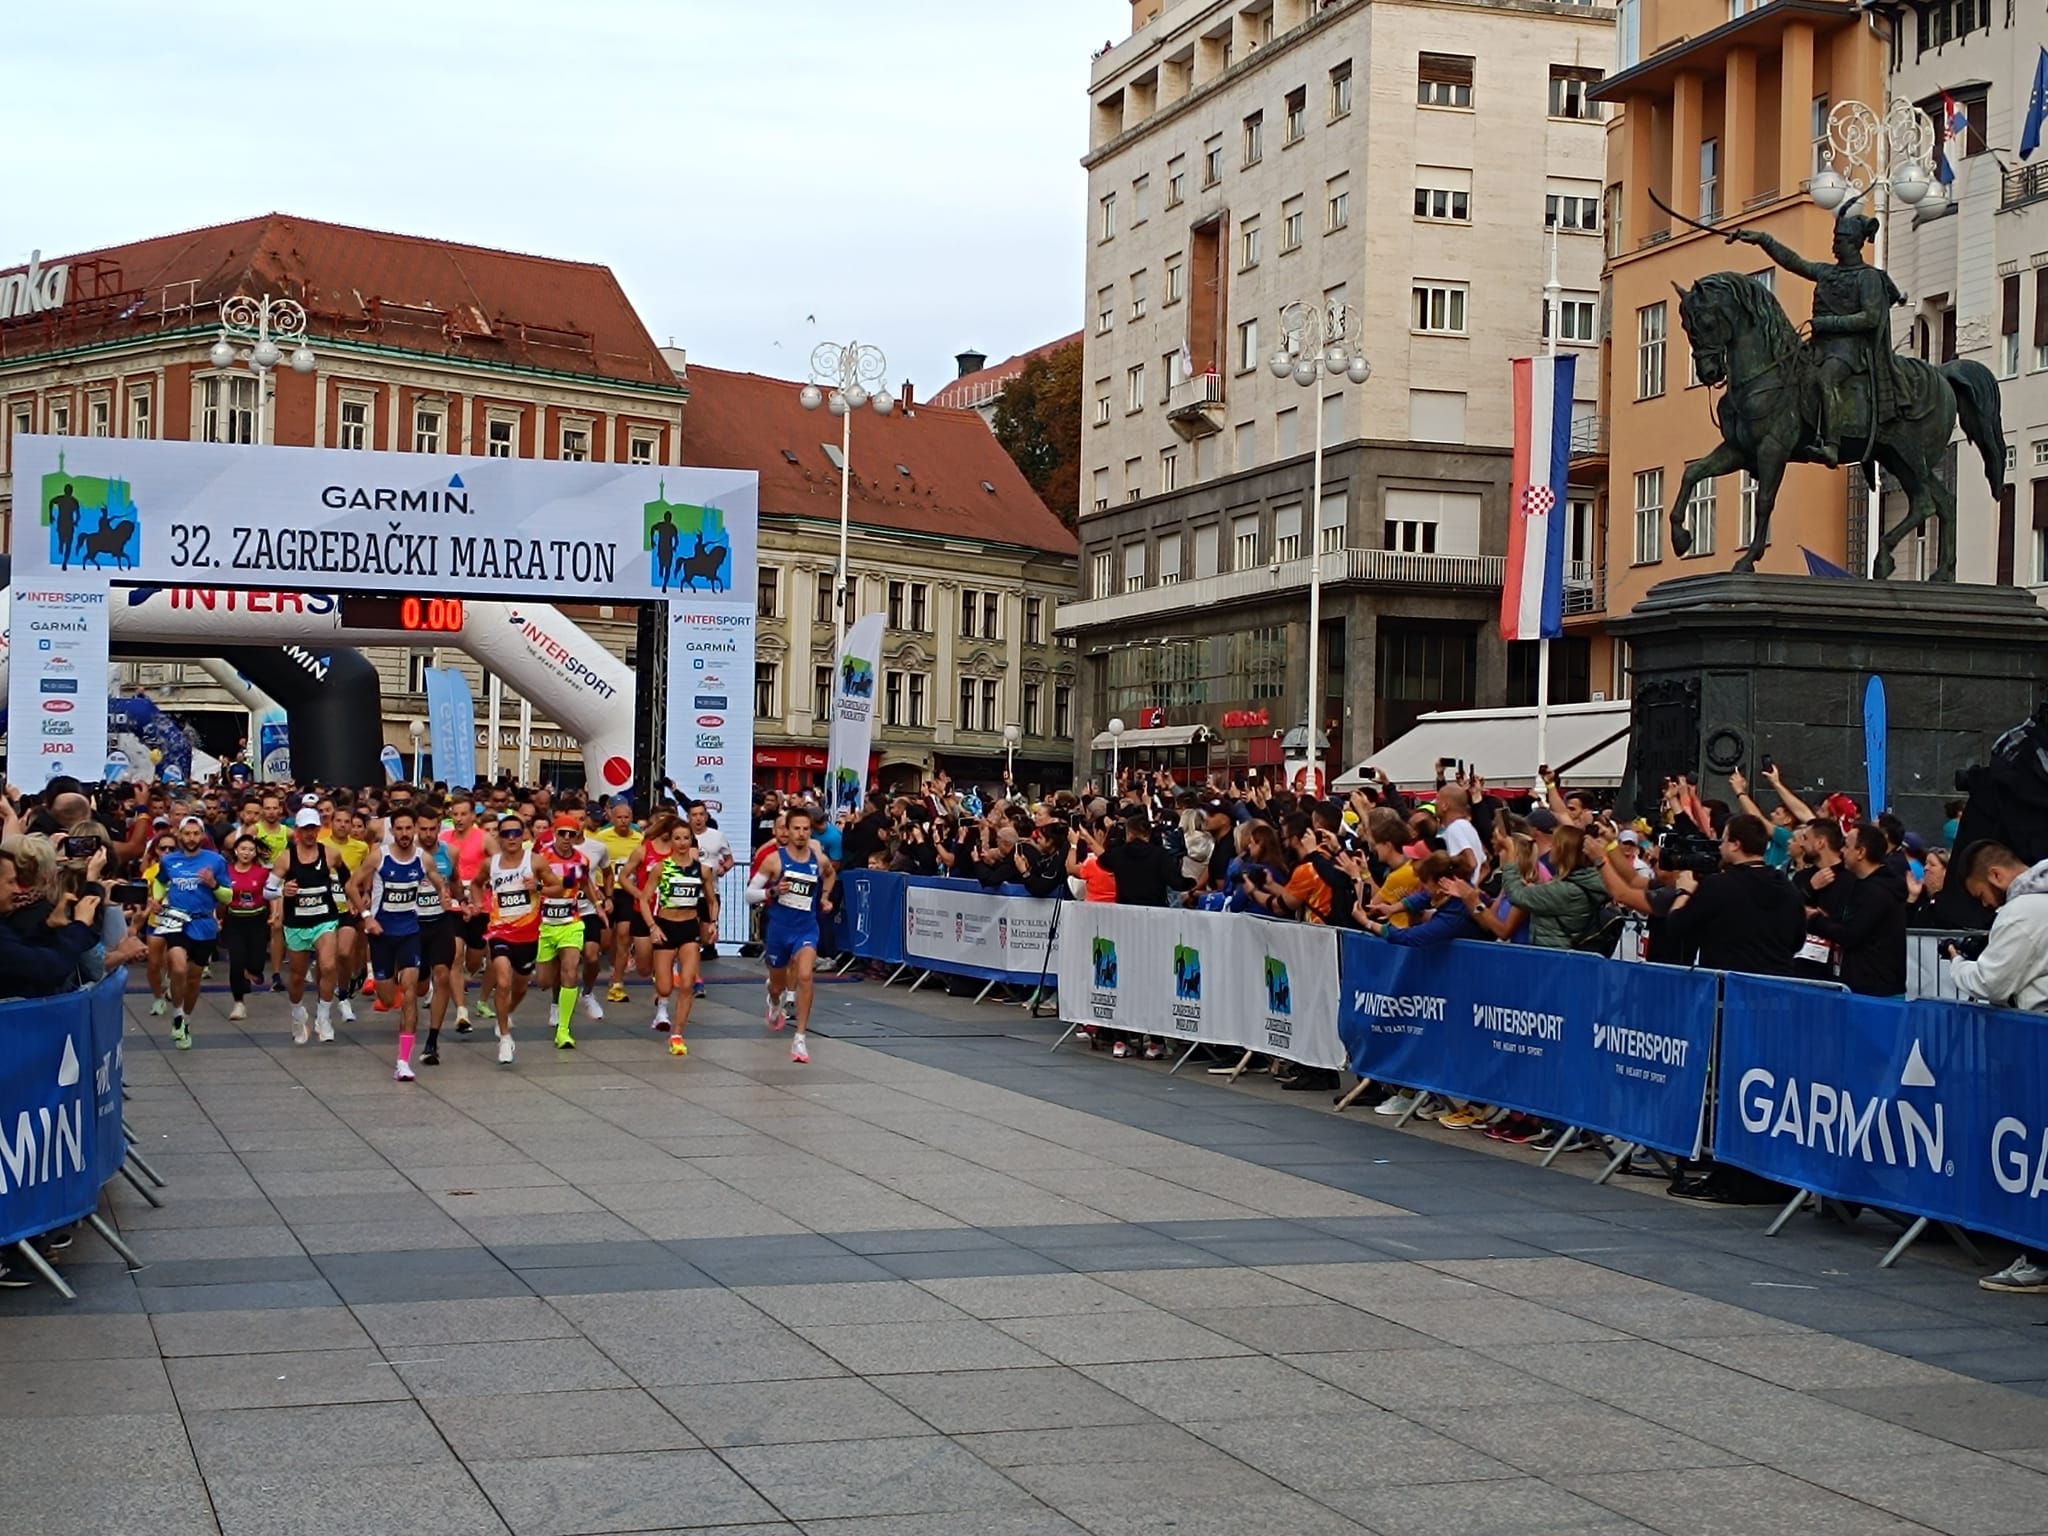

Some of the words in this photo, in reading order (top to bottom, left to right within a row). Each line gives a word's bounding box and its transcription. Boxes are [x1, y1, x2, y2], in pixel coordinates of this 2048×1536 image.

[0, 250, 69, 319] nka
[322, 486, 469, 514] GARMIN
[170, 523, 220, 568] 32.
[231, 521, 438, 576] ZAGREBAČKI
[449, 536, 617, 583] MARATON
[28, 592, 104, 603] INTERSPORT
[30, 621, 87, 631] GARMIN
[684, 615, 751, 626] INTERSPORT
[521, 622, 617, 700] INTERSPORT
[686, 642, 736, 652] GARMIN
[502, 732, 583, 749] HOLDIN
[1364, 992, 1447, 1021] INTERSPORT
[1485, 1005, 1564, 1041] INTERSPORT
[1607, 1025, 1688, 1067] INTERSPORT
[1739, 1068, 1943, 1174] GARMIN
